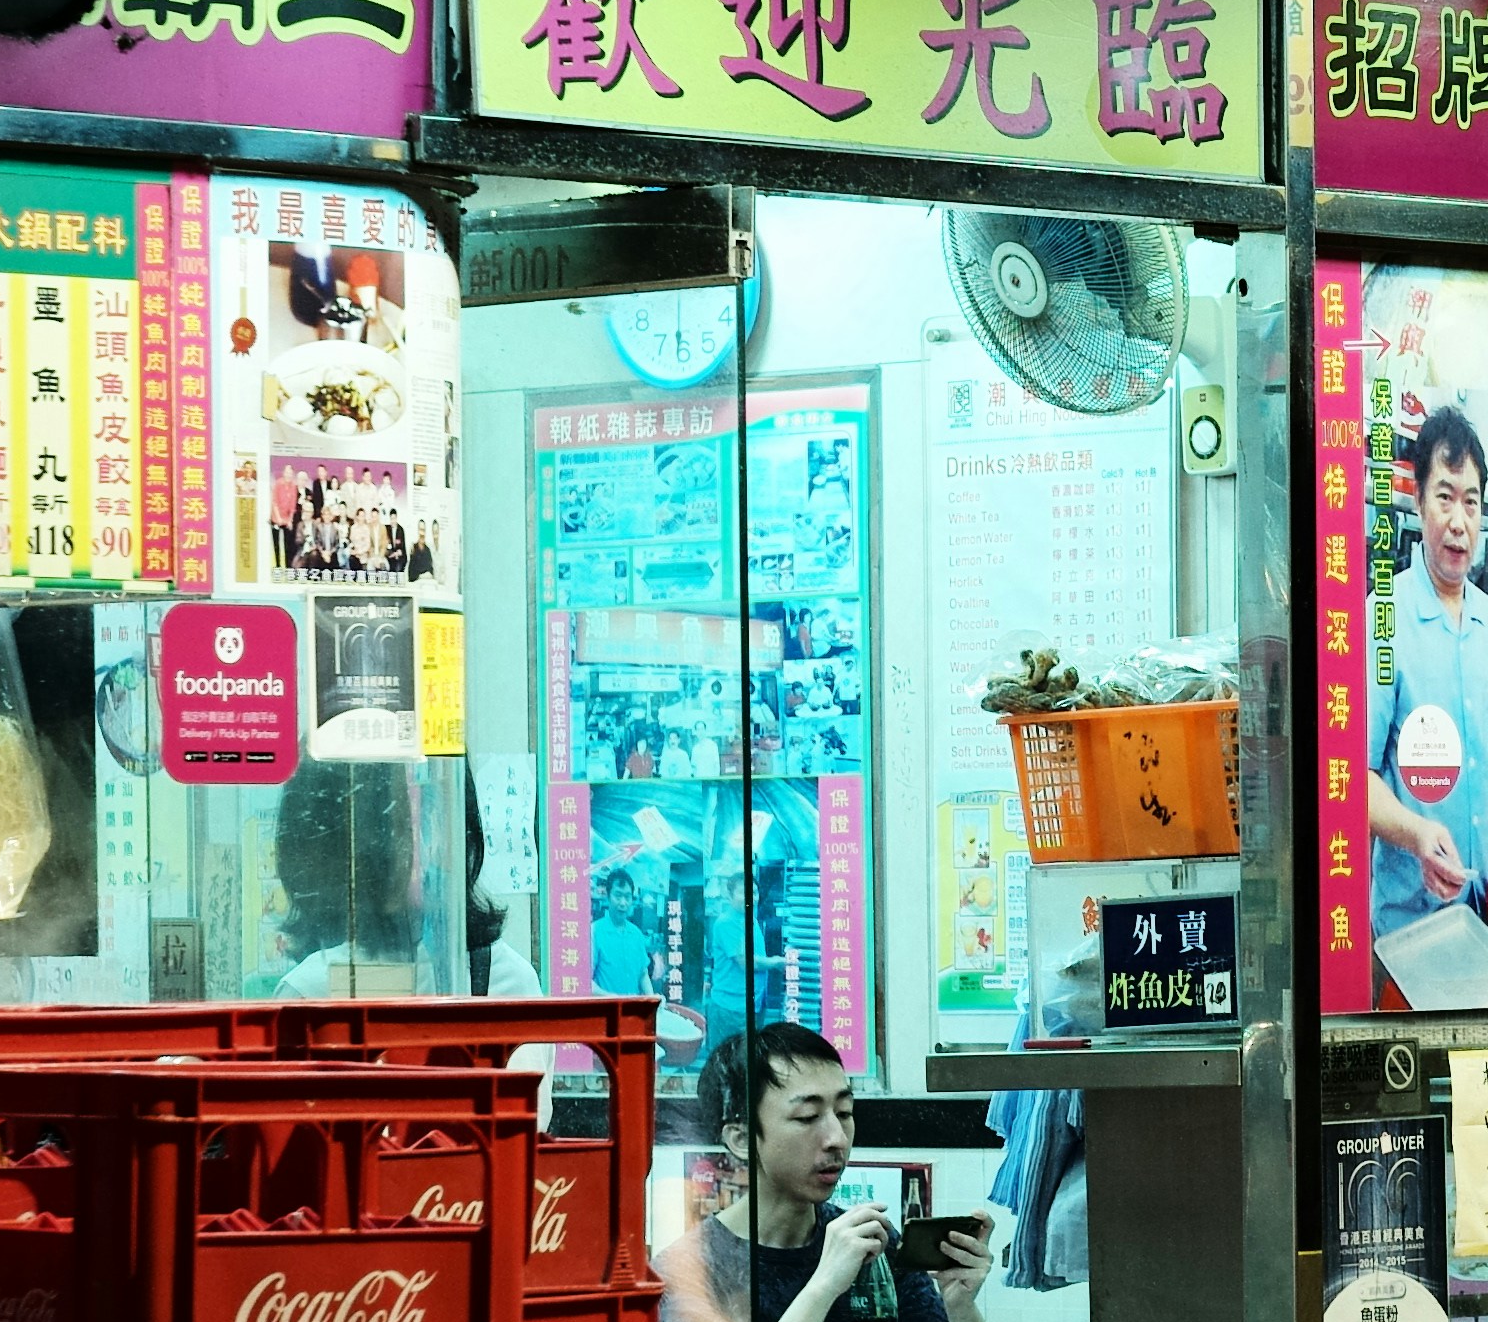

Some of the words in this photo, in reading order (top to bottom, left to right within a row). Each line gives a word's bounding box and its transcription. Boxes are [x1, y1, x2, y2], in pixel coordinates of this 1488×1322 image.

[946, 455, 1006, 478] Drinks
[1011, 449, 1094, 475] 冷熱飲品類
[948, 491, 980, 503] Coffee
[948, 512, 977, 524] White
[981, 511, 1000, 523] Tea
[949, 533, 981, 545] Lemon
[983, 532, 1013, 544] Water
[1369, 378, 1395, 687] 保證百分百即日
[949, 554, 982, 566] Lemon
[986, 553, 1004, 565] Tea
[949, 575, 983, 588] Horlick
[949, 596, 990, 609] Ovaltine
[949, 617, 1000, 630] Chocolate
[175, 671, 284, 701] foodpanda
[179, 728, 212, 740] Delivery
[219, 729, 248, 741] Pick-Up
[251, 729, 280, 740] Partner
[1133, 911, 1208, 955] 外賣
[1109, 969, 1193, 1010] 炸魚皮
